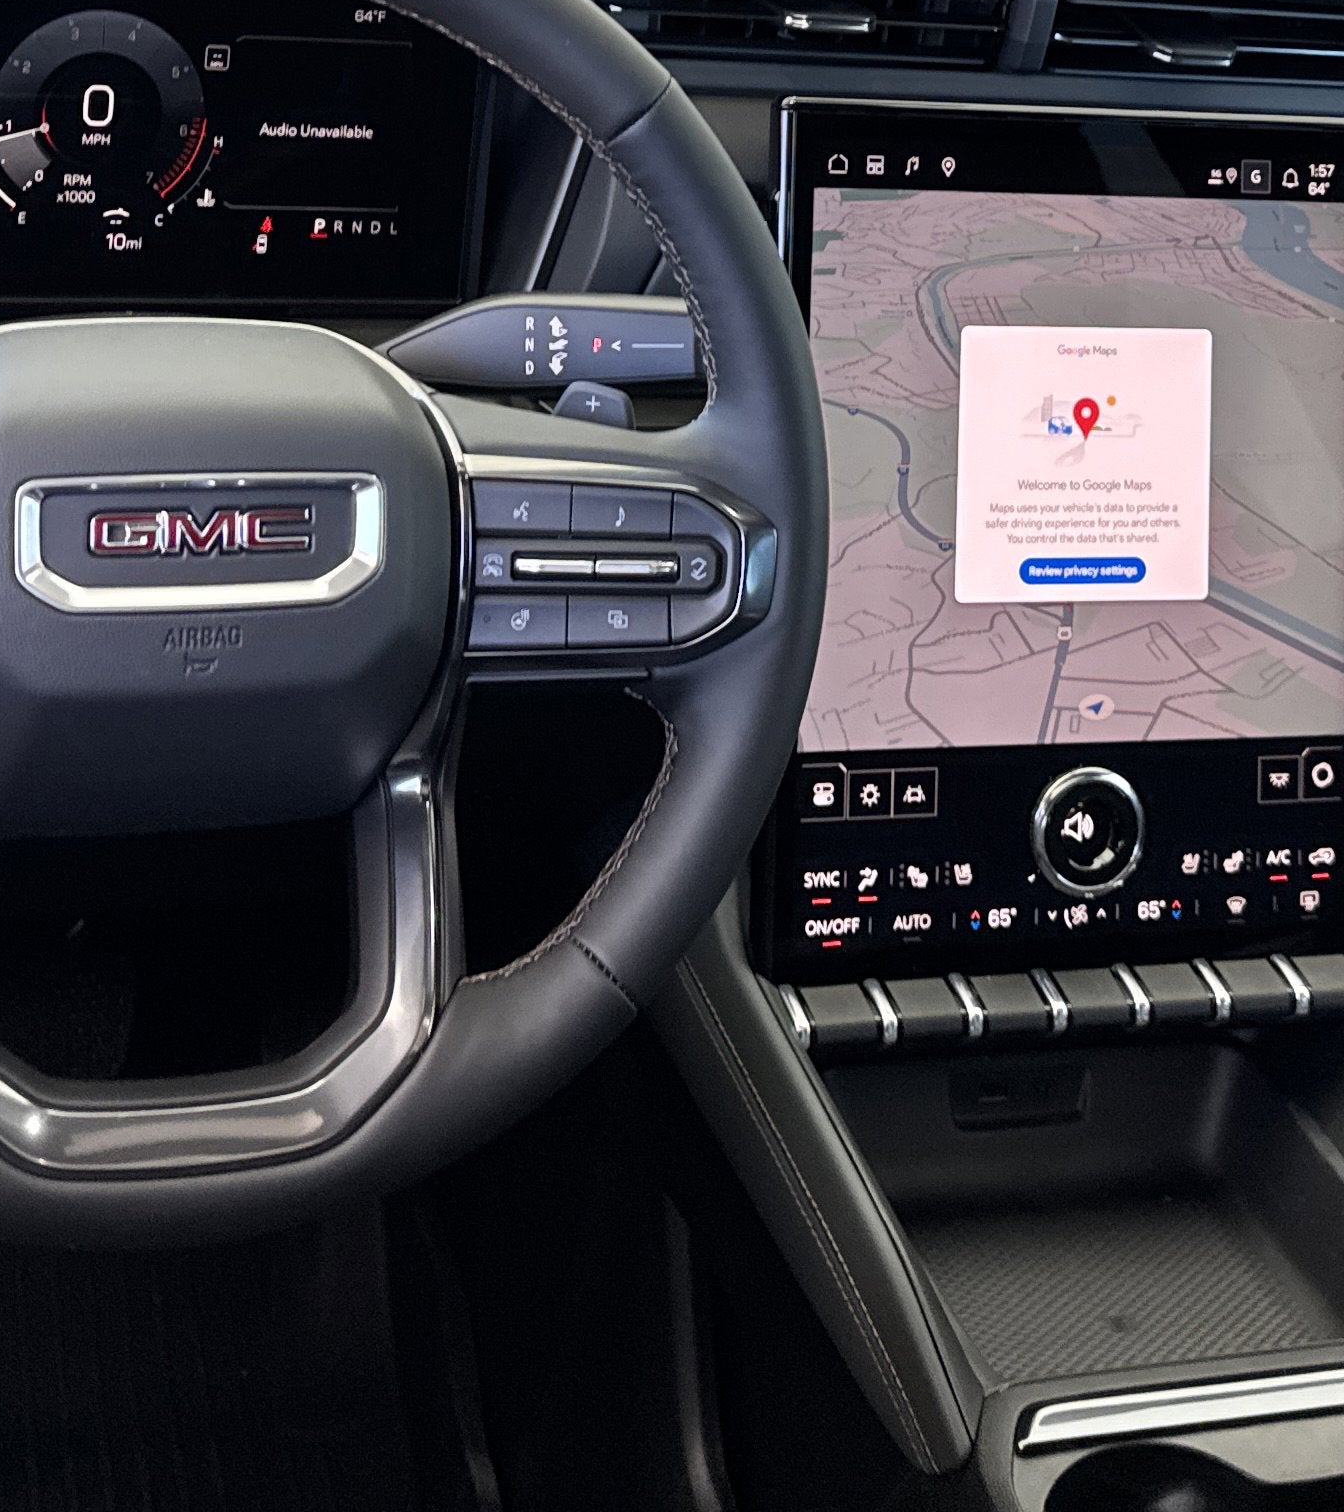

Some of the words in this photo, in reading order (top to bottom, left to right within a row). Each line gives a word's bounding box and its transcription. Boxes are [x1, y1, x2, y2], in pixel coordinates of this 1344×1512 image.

[355, 9, 387, 23] 64°F
[128, 29, 136, 41] 4
[22, 61, 31, 74] 2
[82, 84, 115, 127] 0
[5, 120, 12, 132] 1
[259, 122, 297, 138] Audio
[300, 123, 374, 139] Unavailable
[81, 133, 111, 146] MPH
[214, 136, 224, 147] H
[34, 169, 44, 182] 0
[146, 172, 154, 184] 7
[1250, 169, 1262, 184] G
[1308, 164, 1336, 178] 1:57
[64, 174, 92, 186] RPM
[1307, 181, 1331, 196] 64°
[56, 190, 96, 204] x1000
[17, 211, 27, 225] E
[154, 213, 163, 226] C
[314, 218, 326, 234] P
[334, 220, 343, 234] R
[352, 220, 362, 234] N
[370, 220, 381, 234] D
[390, 221, 397, 235] L
[106, 233, 143, 251] 10mi
[525, 316, 535, 331] R
[525, 338, 535, 352] N
[591, 336, 602, 353] P
[1057, 343, 1091, 357] Google
[1093, 343, 1117, 357] Maps
[525, 361, 535, 375] D
[1017, 479, 1067, 491] Welcome
[1069, 480, 1080, 491] to
[1082, 479, 1121, 493] Google
[1124, 479, 1152, 492] Maps
[989, 503, 1014, 515] Maps
[1017, 505, 1038, 514] uses
[1040, 505, 1060, 516] your
[1062, 502, 1101, 513] vehicle's
[1104, 502, 1124, 513] data
[1126, 503, 1135, 513] to
[1137, 502, 1170, 515] provide
[985, 518, 1008, 529] safer
[1011, 518, 1043, 531] driving
[1044, 518, 1096, 530] experience
[1097, 518, 1110, 528] for
[1112, 519, 1128, 530] you
[1131, 517, 1148, 528] and
[1150, 517, 1181, 528] others.
[90, 508, 315, 555] GMC
[1006, 534, 1023, 544] You
[1025, 533, 1057, 544] control
[1059, 533, 1075, 543] the
[1076, 533, 1097, 543] data
[1098, 533, 1125, 543] that's
[1126, 532, 1160, 543] shared.
[1028, 565, 1063, 577] Review
[1063, 564, 1099, 579] privacy
[1100, 564, 1138, 579] settings
[163, 624, 244, 650] AIRBAG
[1265, 848, 1291, 868] A/C
[803, 870, 840, 889] SYNC
[1137, 899, 1167, 921] 65°
[804, 916, 860, 937] ON/OFF
[892, 913, 932, 931] AUTO
[987, 907, 1018, 929] 65°
